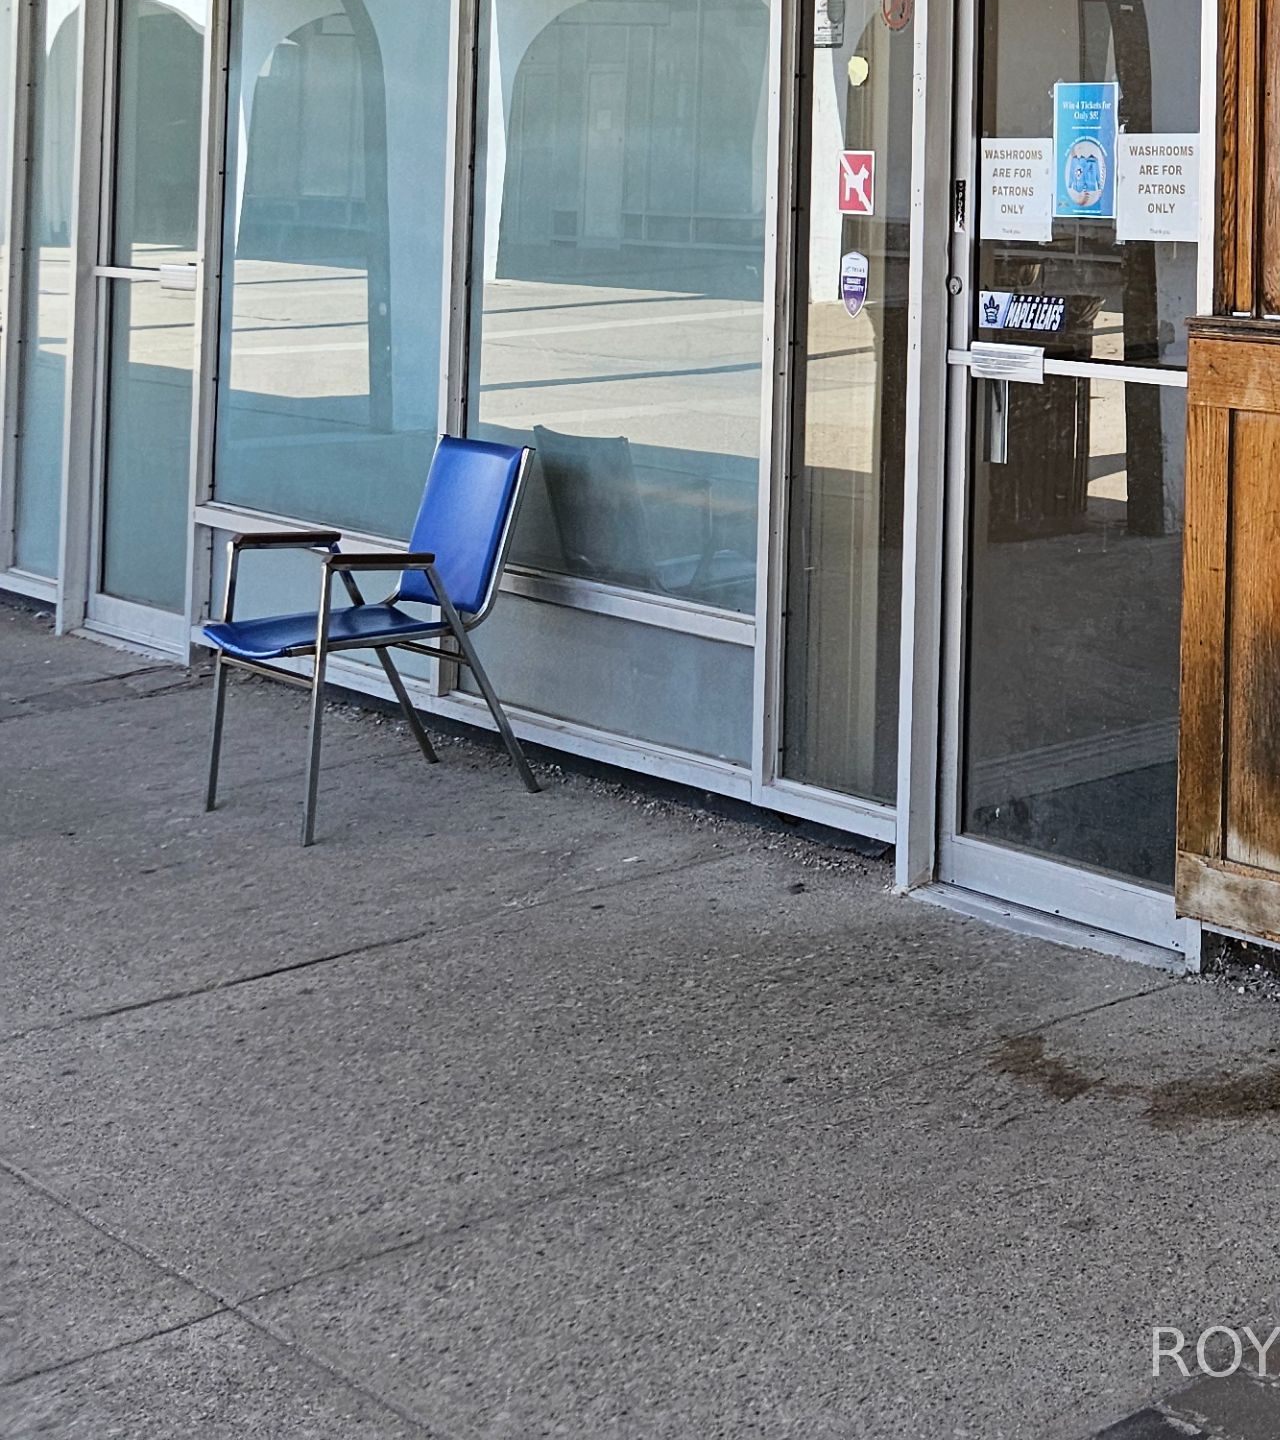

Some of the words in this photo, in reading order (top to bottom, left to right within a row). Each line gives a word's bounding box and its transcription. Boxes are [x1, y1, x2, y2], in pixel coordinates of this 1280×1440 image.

[984, 148, 1043, 161] WASHROOMS
[1129, 145, 1195, 157] WASHROOMS
[992, 167, 1011, 178] ARE
[1013, 168, 1032, 178] FOR
[1139, 165, 1159, 176] ARE
[1162, 165, 1183, 176] FOR
[992, 185, 1034, 197] PATRONS
[1138, 183, 1186, 195] PATRONS
[1000, 204, 1025, 215] ONLY
[1147, 202, 1176, 214] ONLY
[1013, 295, 1064, 305] TORONTO
[1004, 301, 1037, 330] MAPLE
[1032, 303, 1065, 331] LEAFS
